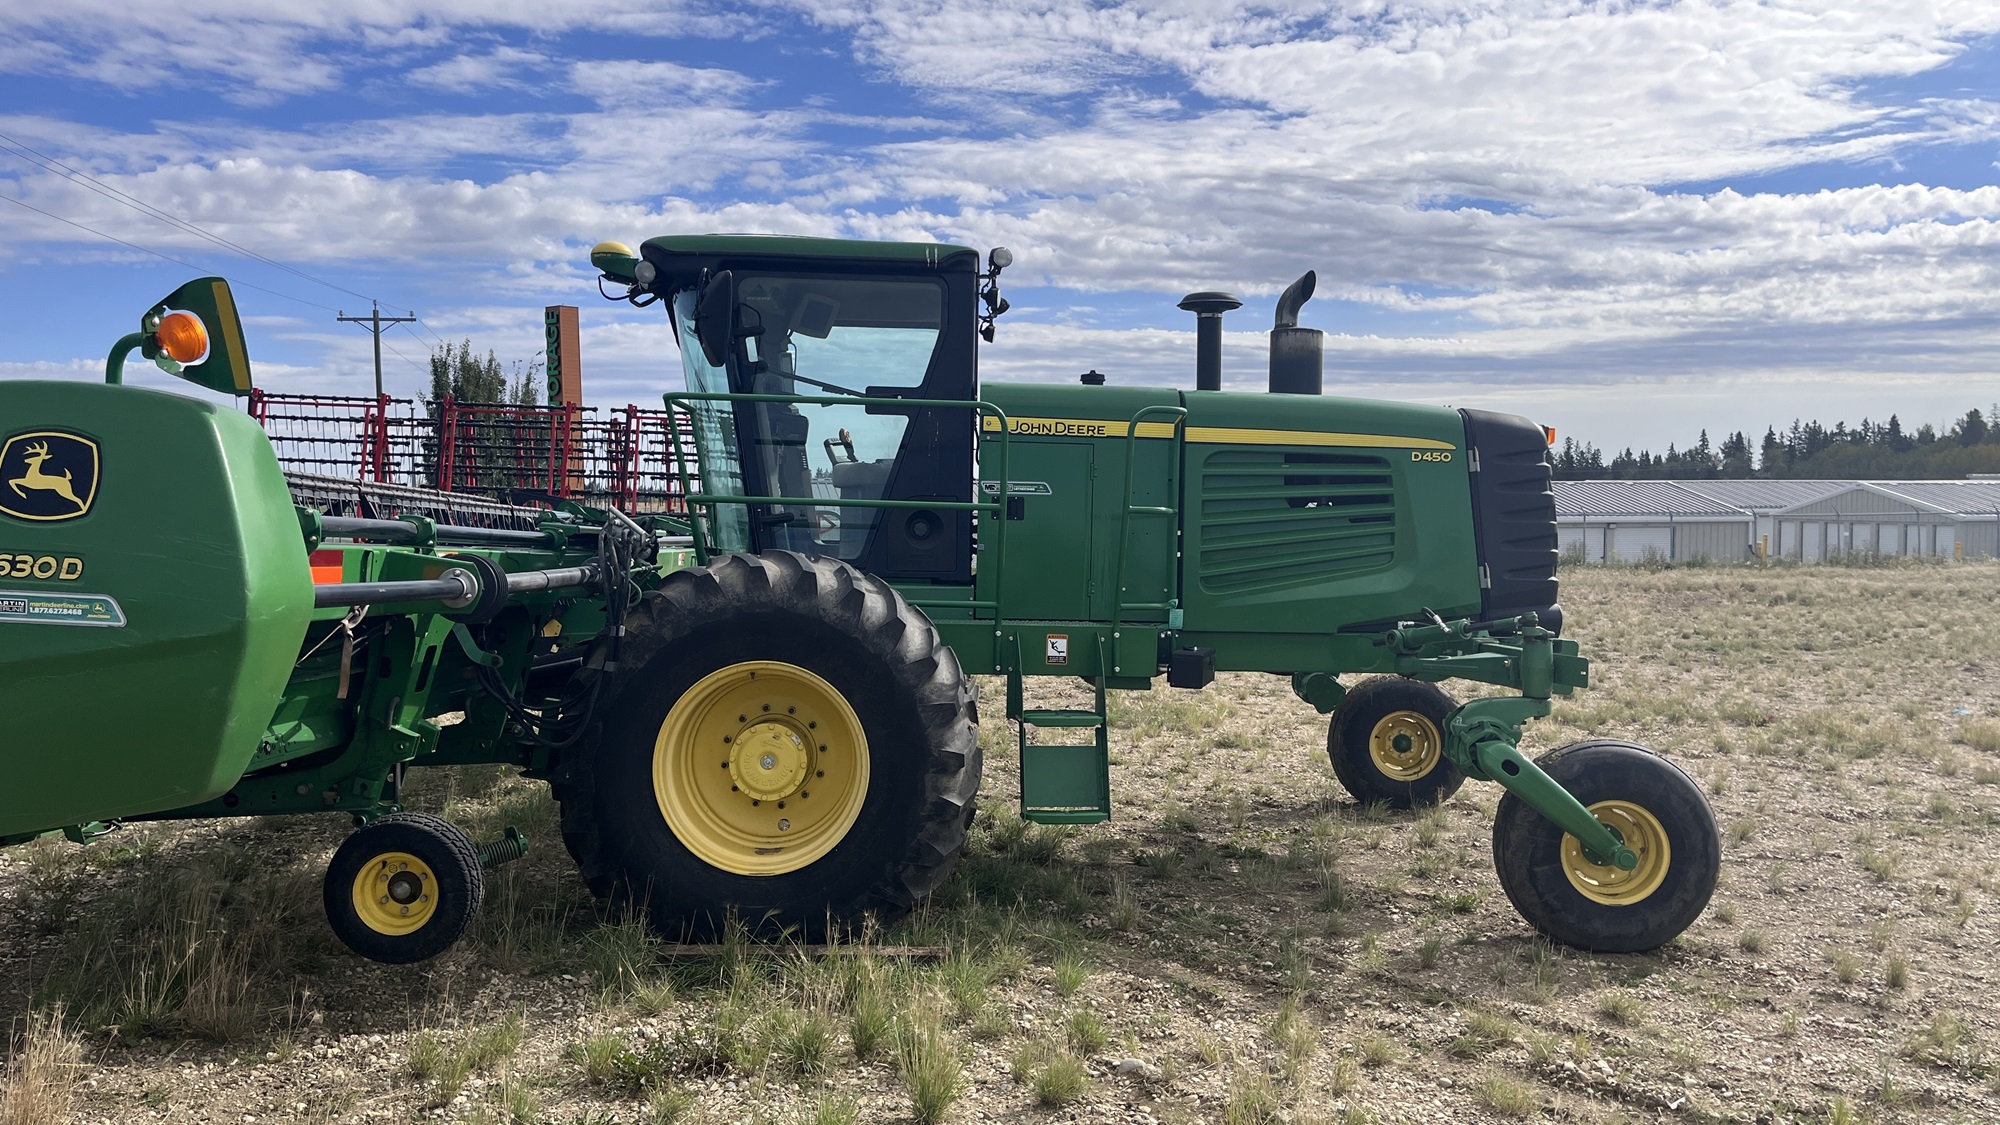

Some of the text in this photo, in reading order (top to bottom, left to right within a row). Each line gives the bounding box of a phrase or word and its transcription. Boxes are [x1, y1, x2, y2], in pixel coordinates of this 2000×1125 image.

[1010, 420, 1106, 435] JOHN DEERE
[1411, 451, 1452, 463] D450
[29, 601, 90, 610] martindeerline.com
[29, 606, 83, 615] 1.877.627.8468
